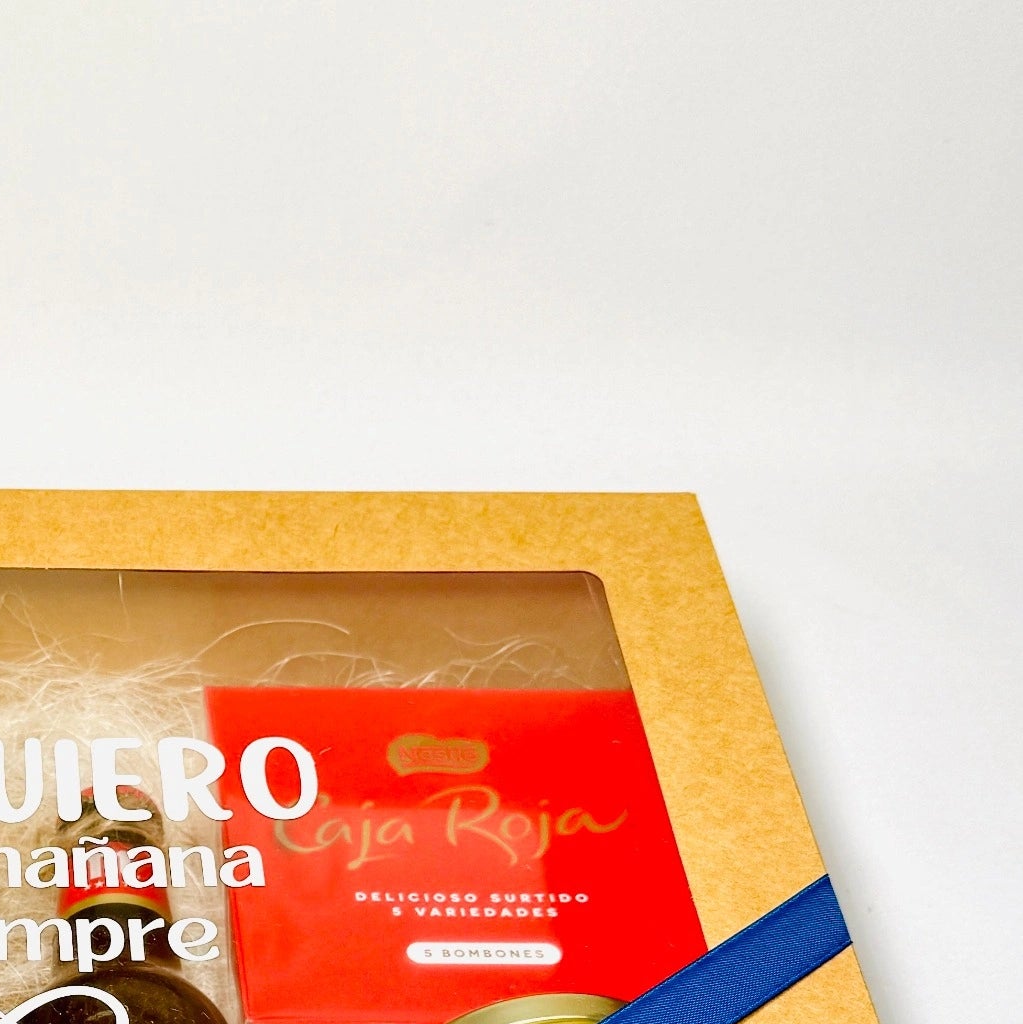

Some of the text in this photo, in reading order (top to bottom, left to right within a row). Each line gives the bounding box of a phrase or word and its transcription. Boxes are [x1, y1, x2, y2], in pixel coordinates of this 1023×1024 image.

[273, 784, 627, 871] Caja Roja
[354, 891, 589, 903] DELICIOSO SURTIDO
[392, 906, 559, 918] 5 VARIEDADES
[423, 949, 545, 959] 5 BOMBONES
